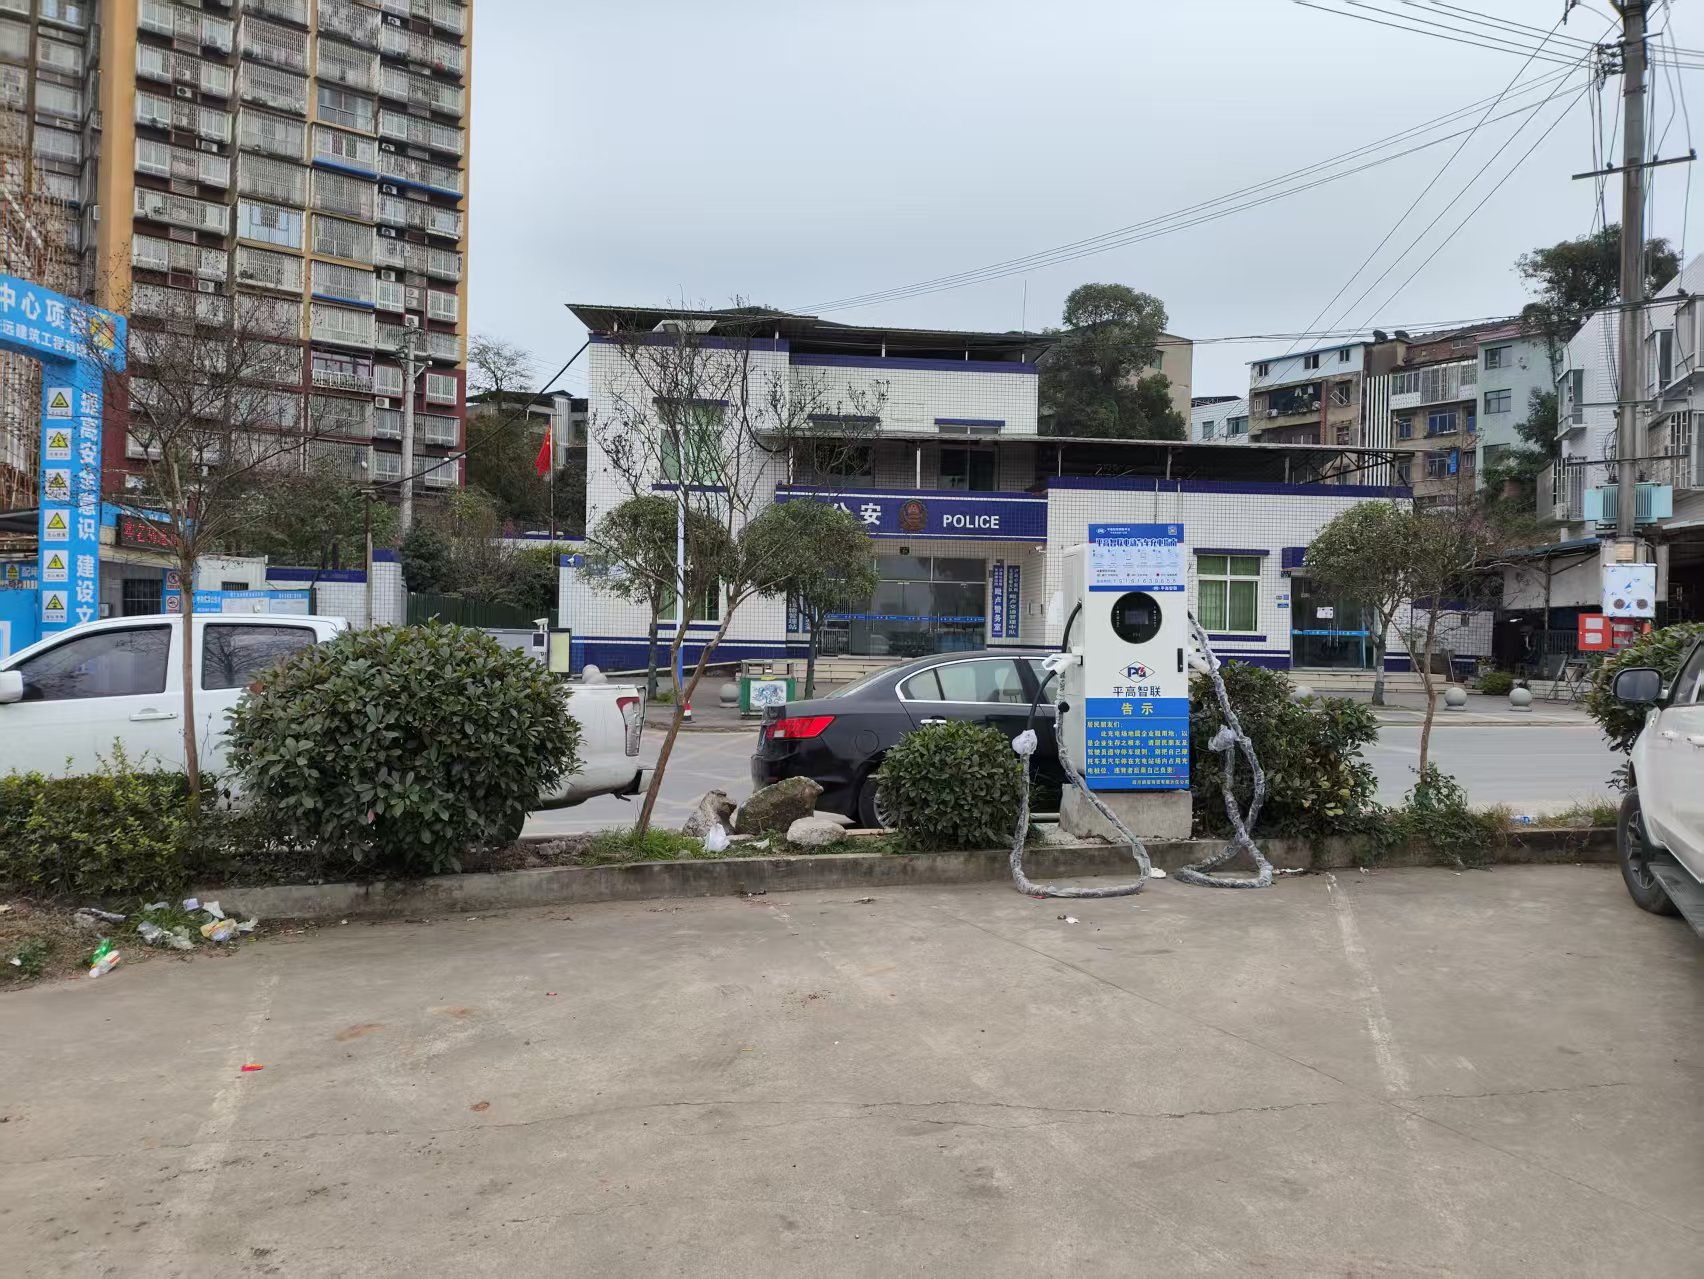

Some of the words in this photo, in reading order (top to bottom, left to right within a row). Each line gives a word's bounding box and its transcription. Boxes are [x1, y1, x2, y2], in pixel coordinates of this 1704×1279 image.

[943, 514, 1000, 529] POLICE
[1112, 685, 1162, 697] 平高智联
[1121, 702, 1154, 715] 告示
